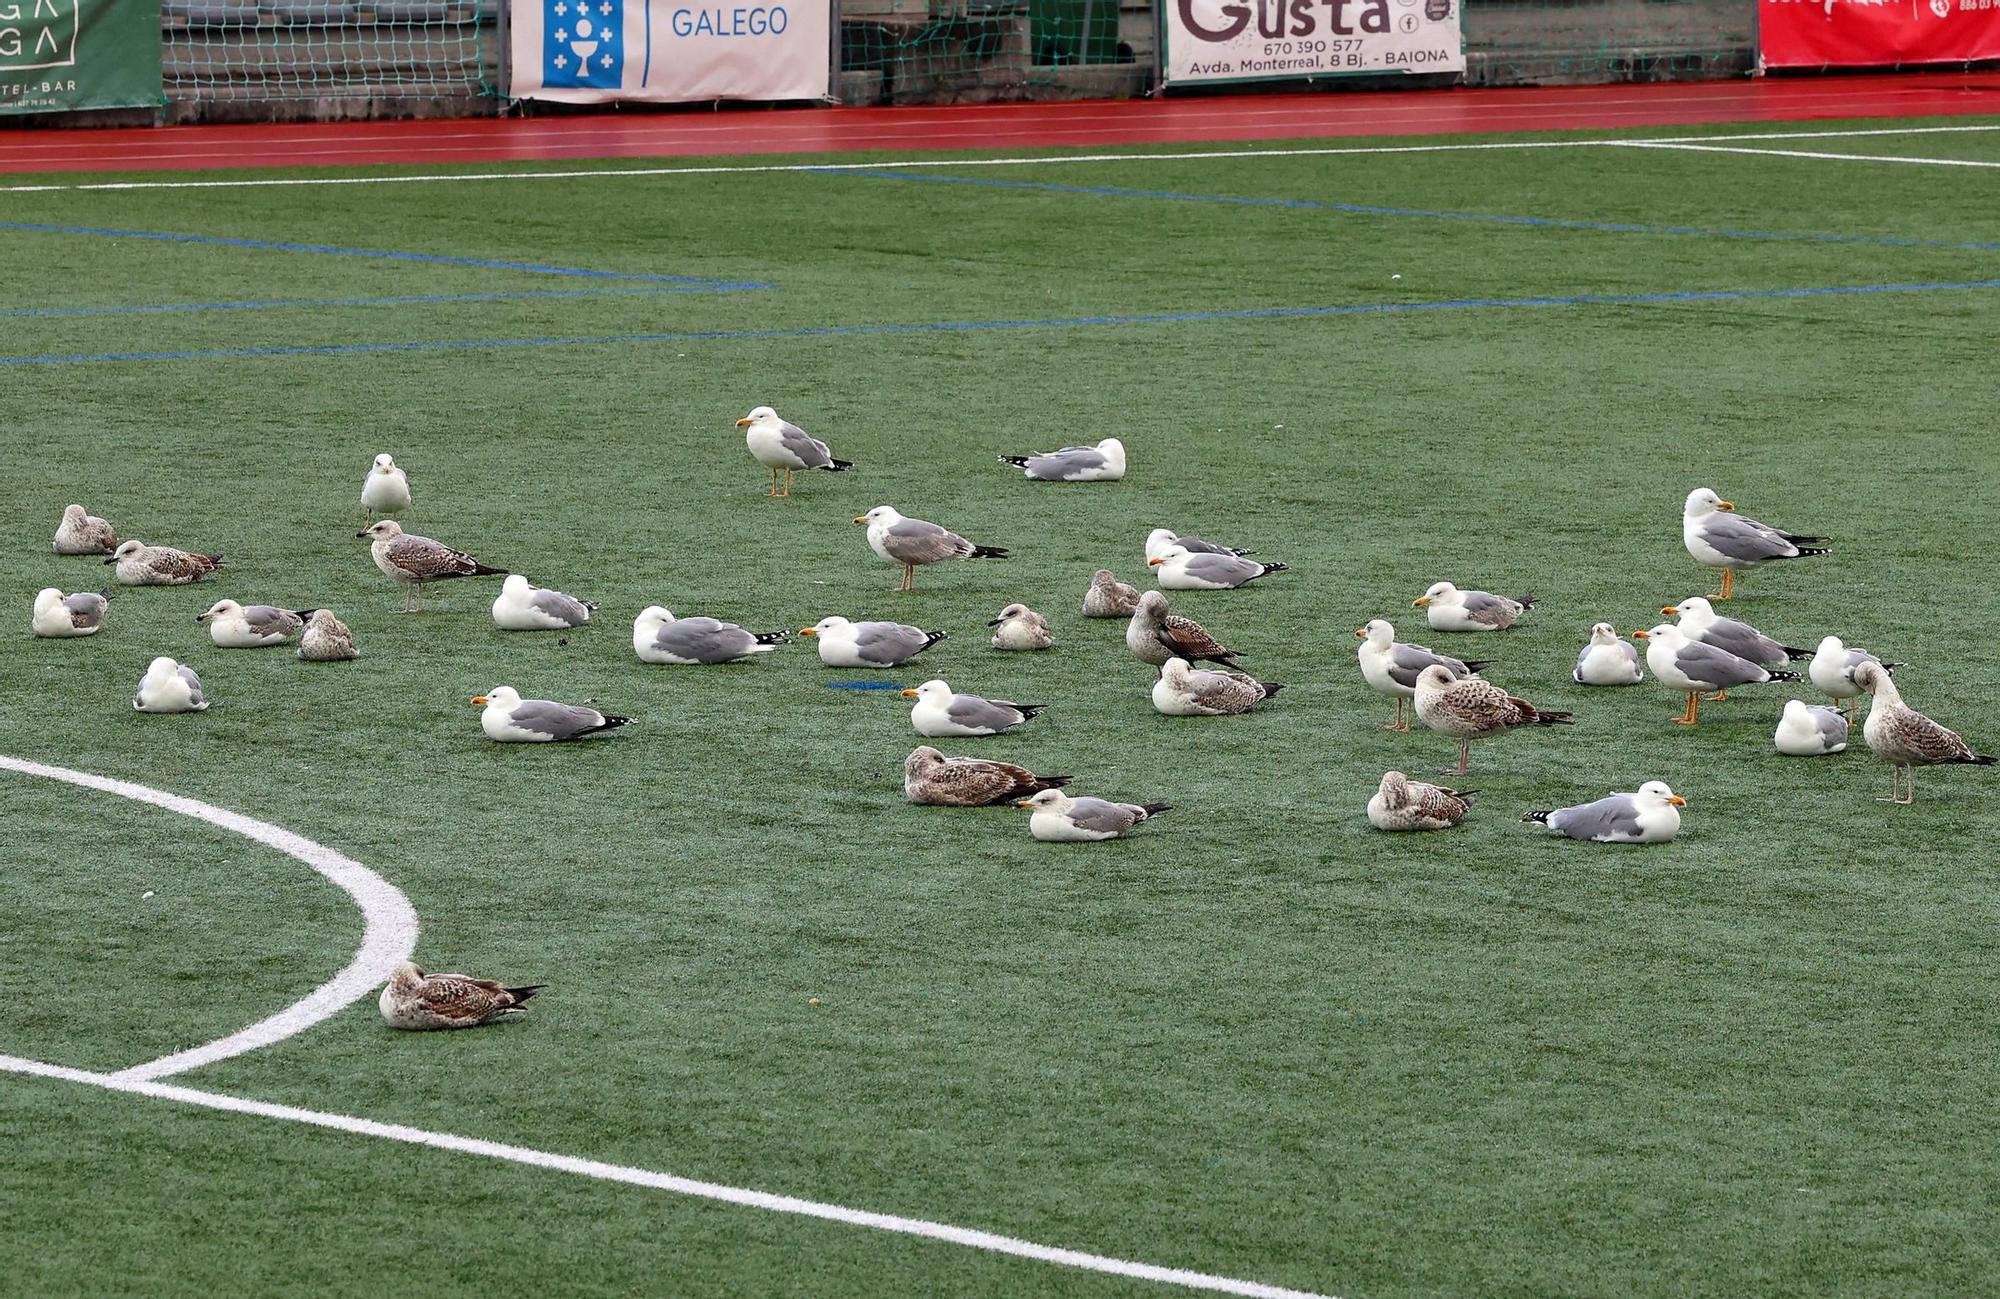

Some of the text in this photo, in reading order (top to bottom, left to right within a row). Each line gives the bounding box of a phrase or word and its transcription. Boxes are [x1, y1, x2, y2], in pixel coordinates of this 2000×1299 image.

[672, 6, 788, 37] GALEGO
[1178, 0, 1392, 42] Gusta
[1264, 39, 1363, 56] 670 390 577
[1189, 61, 1235, 75] Avda.
[1240, 56, 1324, 72] Monterreal,
[1330, 55, 1340, 67] 8
[1347, 53, 1367, 68] Bj.
[1385, 50, 1449, 64] BAIONA
